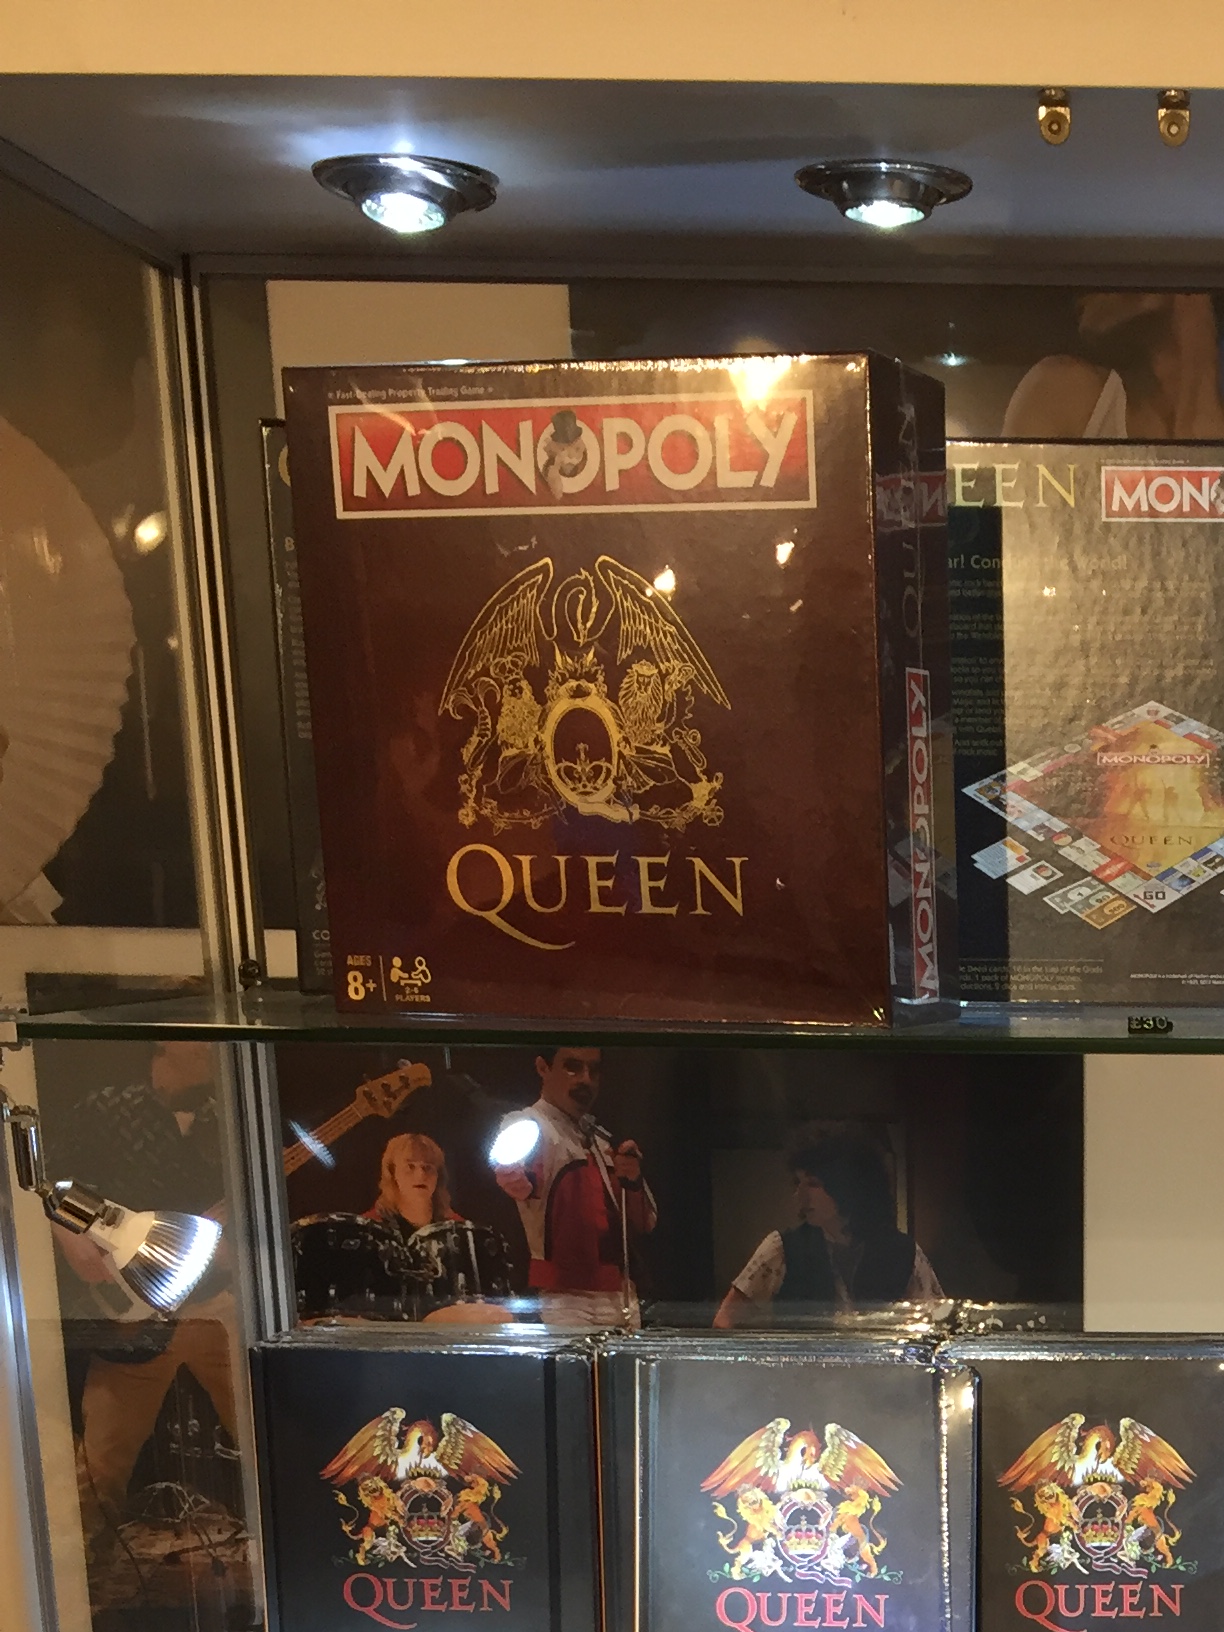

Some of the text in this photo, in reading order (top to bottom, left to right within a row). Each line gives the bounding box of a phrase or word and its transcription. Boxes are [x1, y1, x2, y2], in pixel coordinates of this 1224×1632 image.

[460, 386, 485, 396] Game
[353, 411, 798, 499] MONOPOLY
[953, 460, 1079, 509] EEN
[1101, 753, 1206, 765] MONOPOLY
[1110, 834, 1194, 849] QUEEN
[446, 843, 749, 950] QUEEN
[1143, 889, 1166, 901] GO
[346, 955, 372, 967] AGES
[347, 970, 377, 1000] 8+
[395, 994, 431, 1002] PLAYERS
[1130, 1016, 1168, 1030] £30
[343, 1572, 513, 1630] QUEEN
